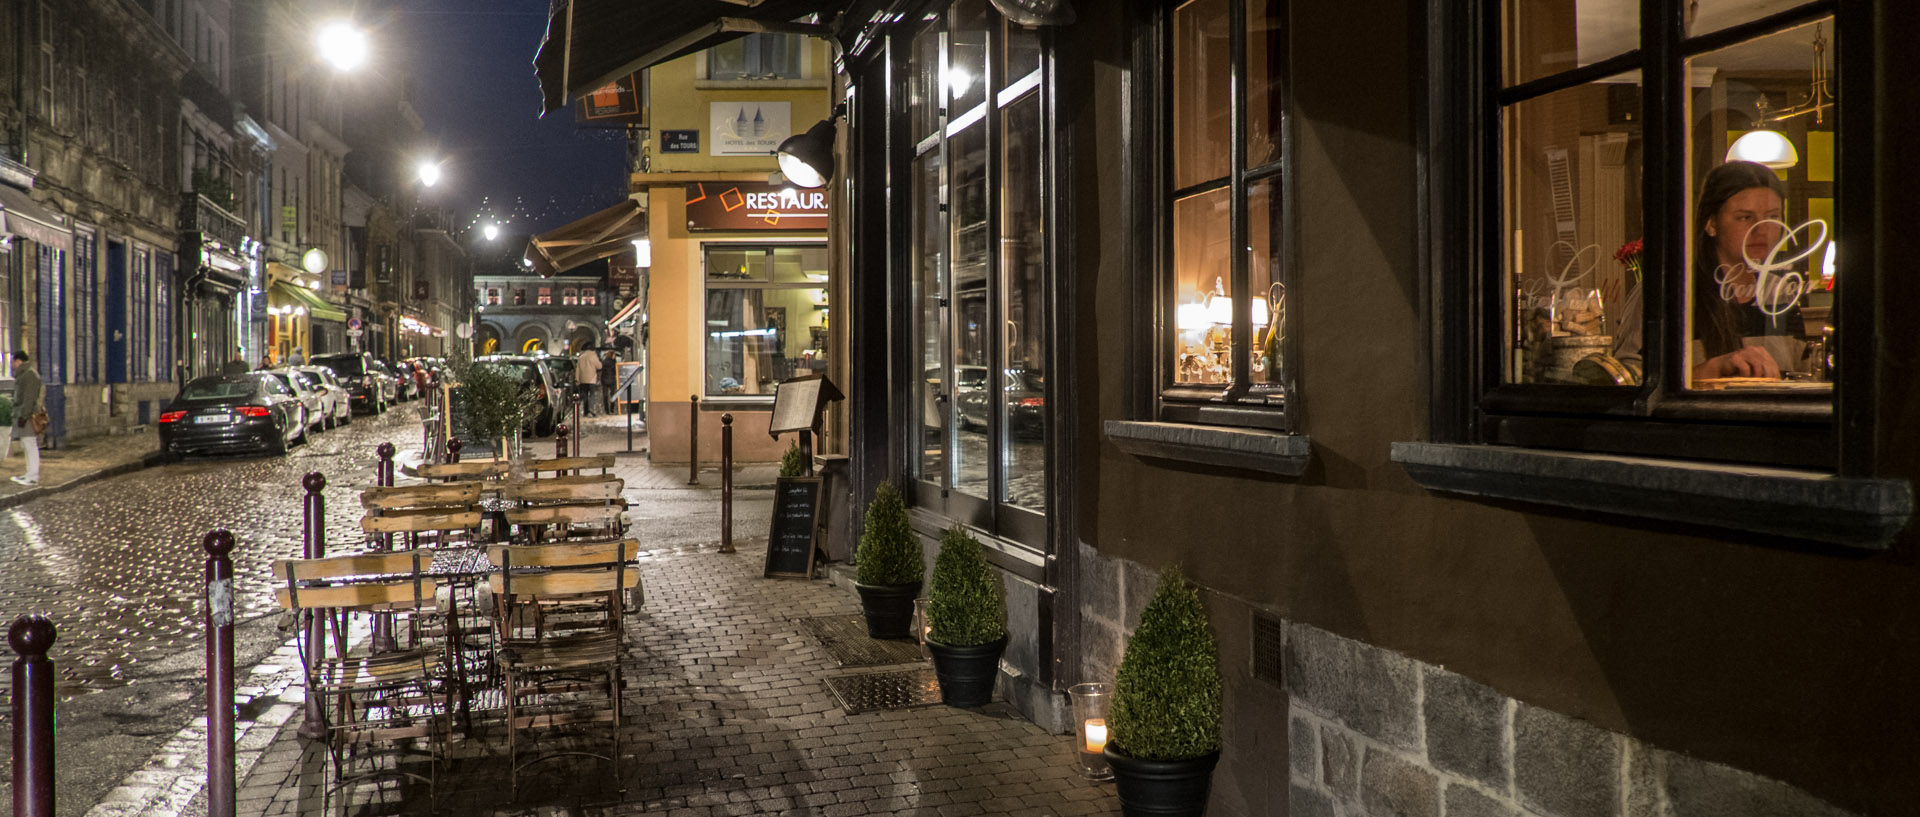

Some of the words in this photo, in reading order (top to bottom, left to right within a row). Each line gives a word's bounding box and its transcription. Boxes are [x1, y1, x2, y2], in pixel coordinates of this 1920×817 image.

[678, 133, 689, 141] Rue
[670, 142, 680, 150] des
[680, 142, 697, 150] TOURS
[746, 192, 829, 210] RESTAUR
